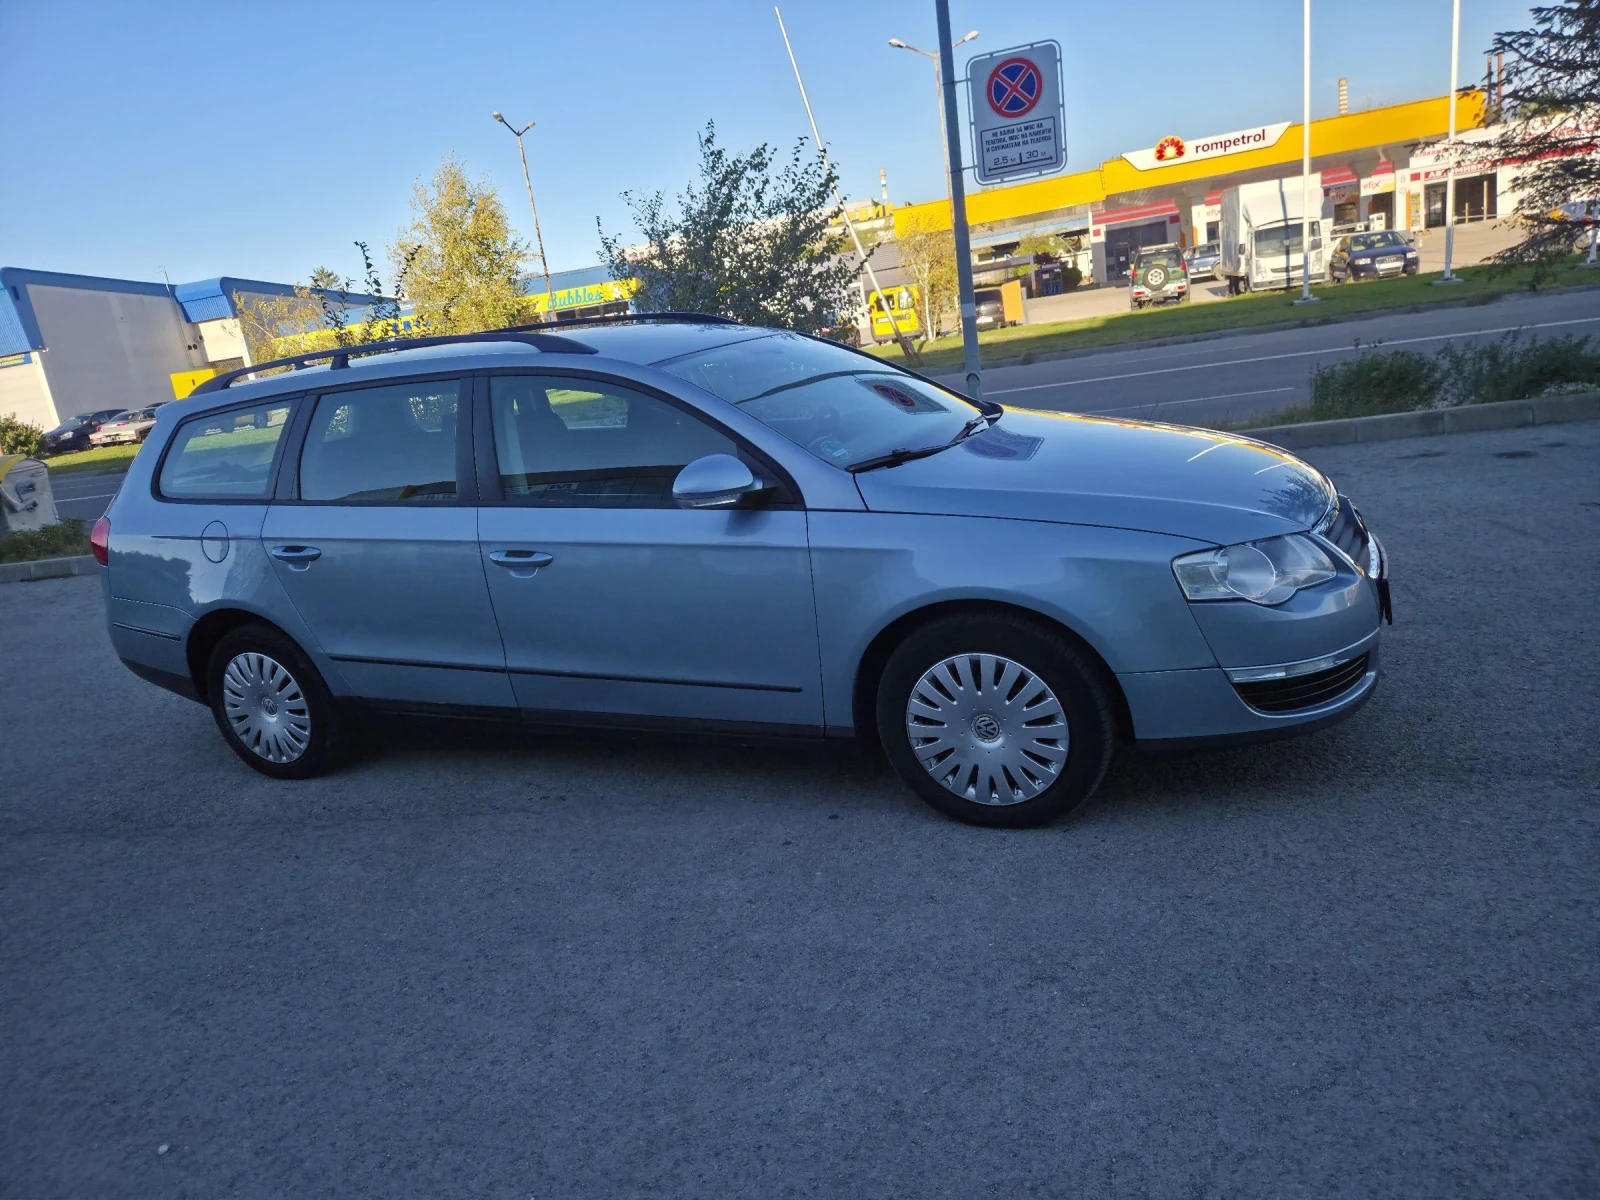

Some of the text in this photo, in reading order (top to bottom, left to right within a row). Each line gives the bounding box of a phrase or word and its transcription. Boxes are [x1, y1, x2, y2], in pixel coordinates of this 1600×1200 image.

[1021, 131, 1028, 139] НА
[1195, 128, 1266, 154] rompetrol
[1026, 150, 1039, 159] 30
[993, 155, 1009, 166] 2.5
[1363, 180, 1381, 190] efix
[1331, 191, 1347, 201] efix
[548, 287, 602, 310] Bubbles
